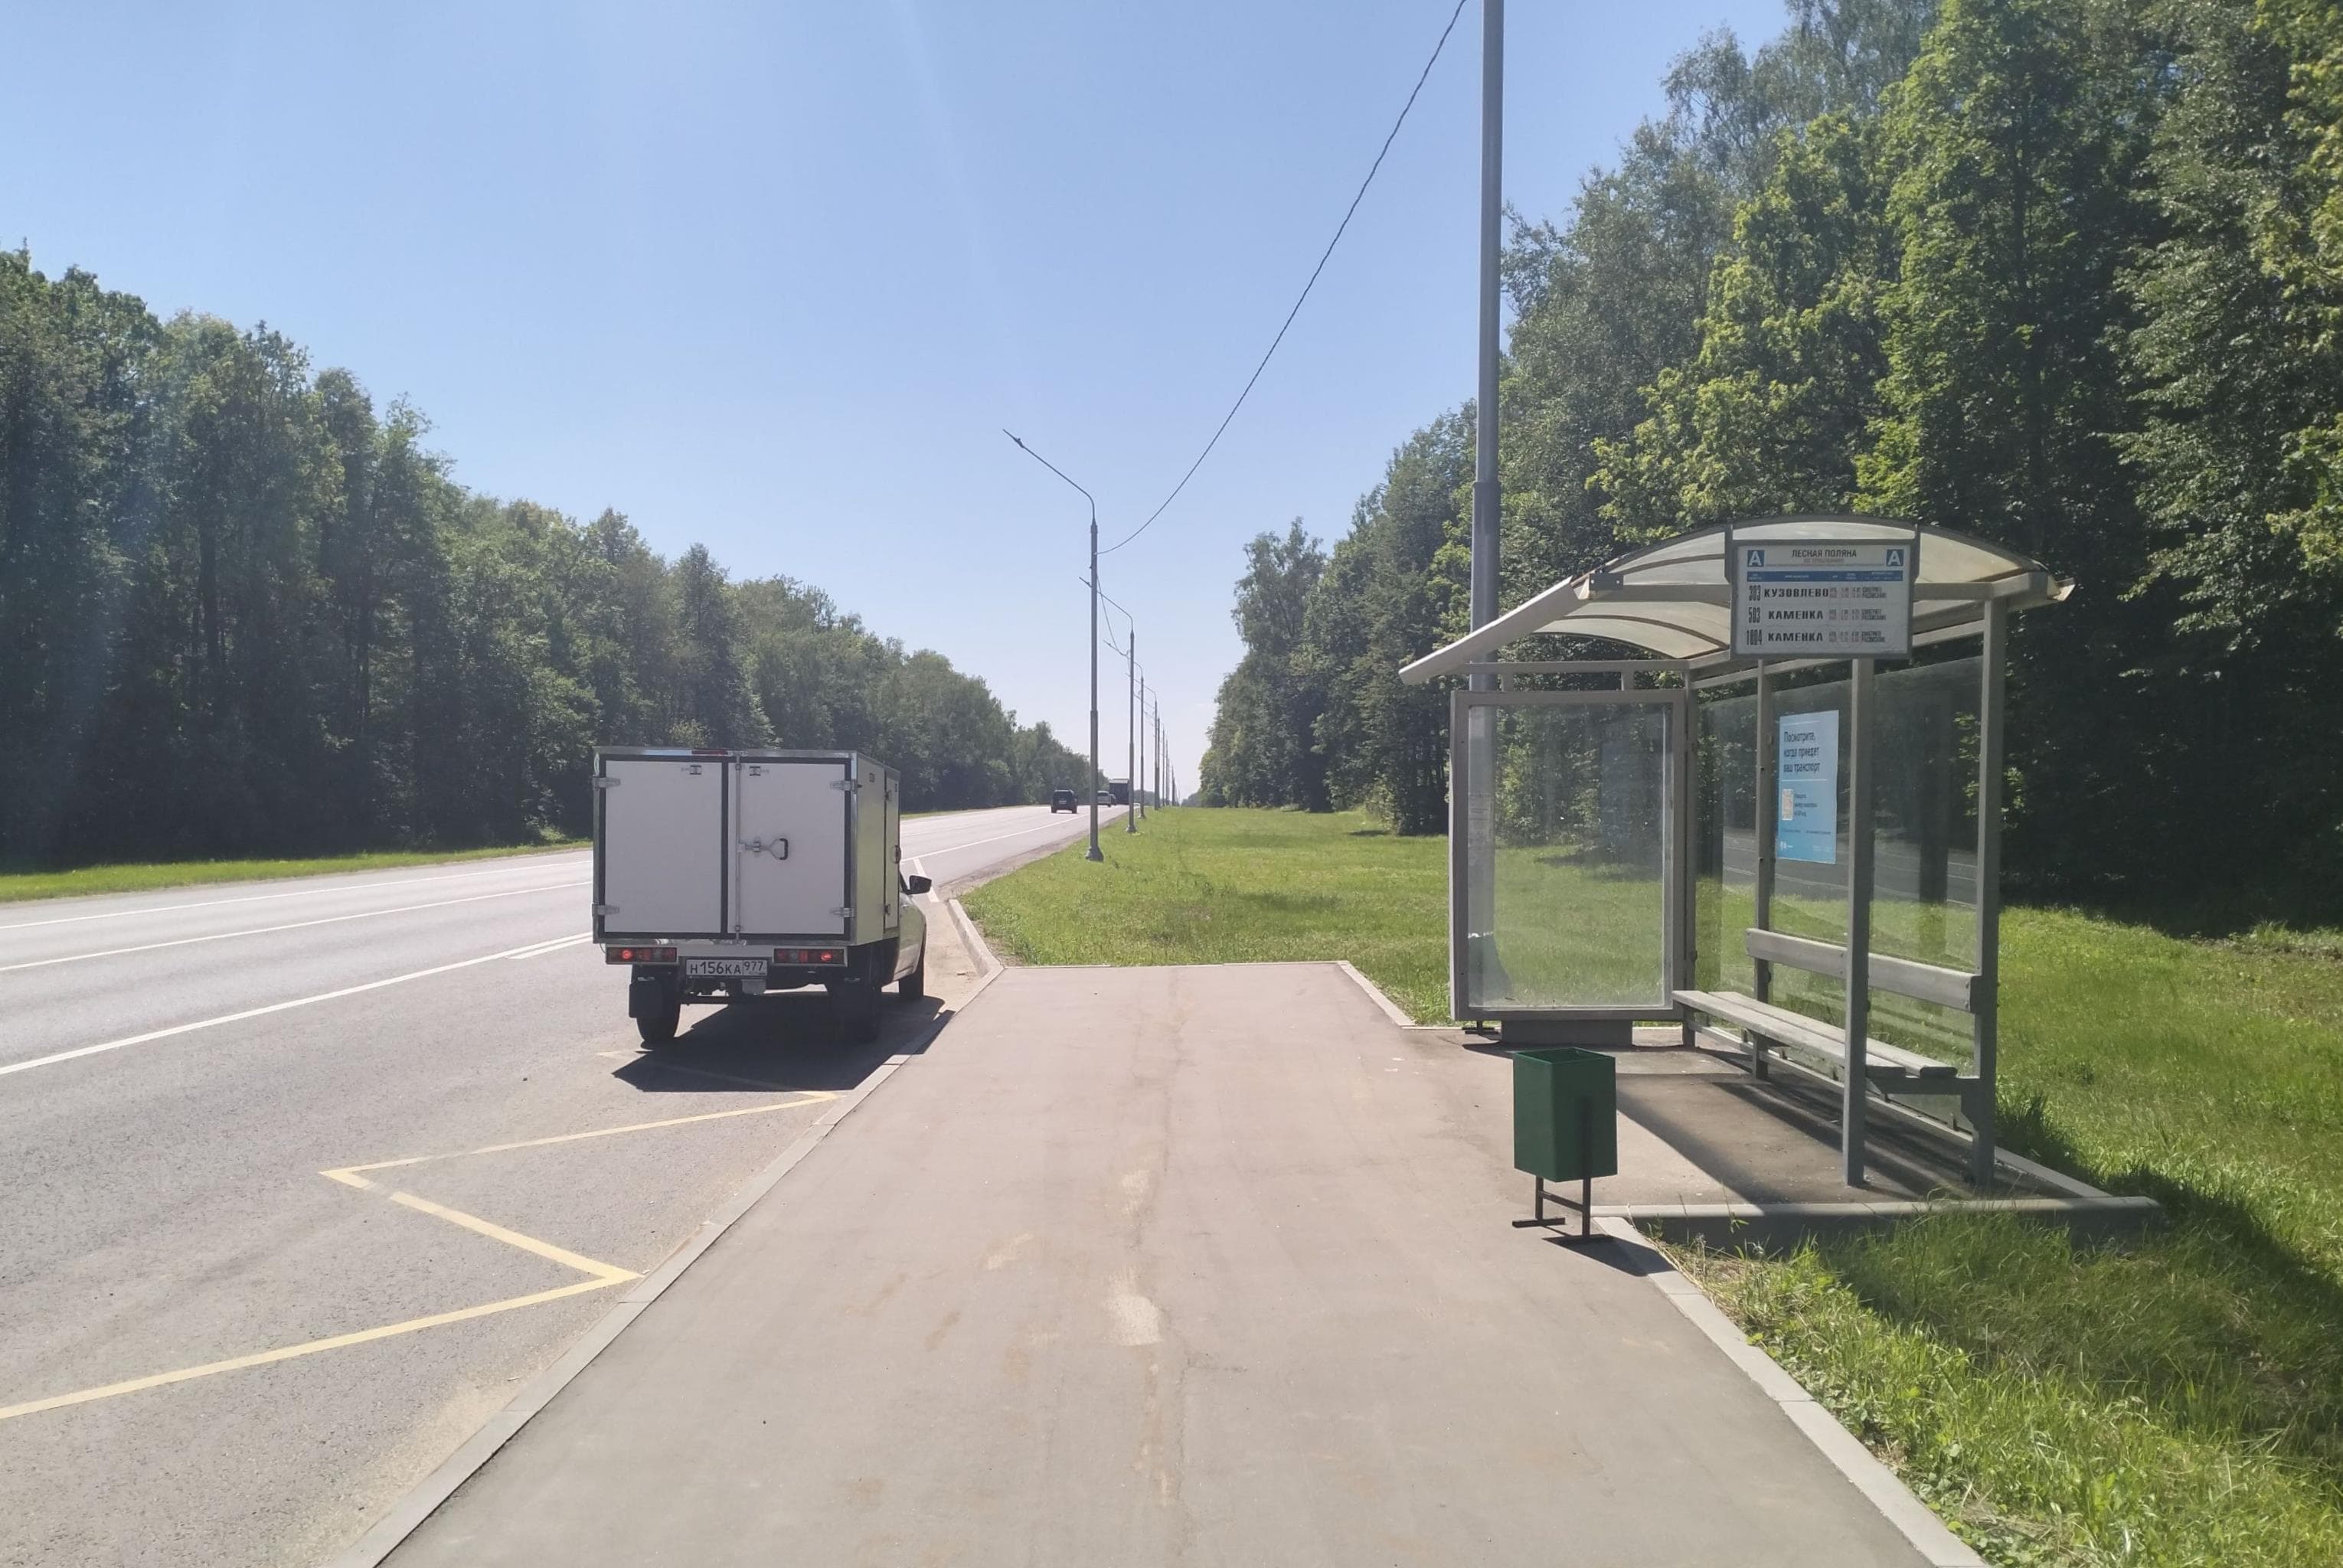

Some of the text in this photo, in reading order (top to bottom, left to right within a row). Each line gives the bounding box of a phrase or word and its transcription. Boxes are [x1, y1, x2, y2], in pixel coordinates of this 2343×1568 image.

[1792, 549, 1857, 558] ЛЕСНАЯ ПОЛЯНА
[1764, 588, 1828, 597] КУЗОВЛЕВО
[1768, 610, 1823, 619] КАМЕНКА
[1768, 632, 1823, 642] КАМЕНКА
[1793, 763, 1820, 774] транспорт
[690, 961, 763, 975] Н156КА 977
